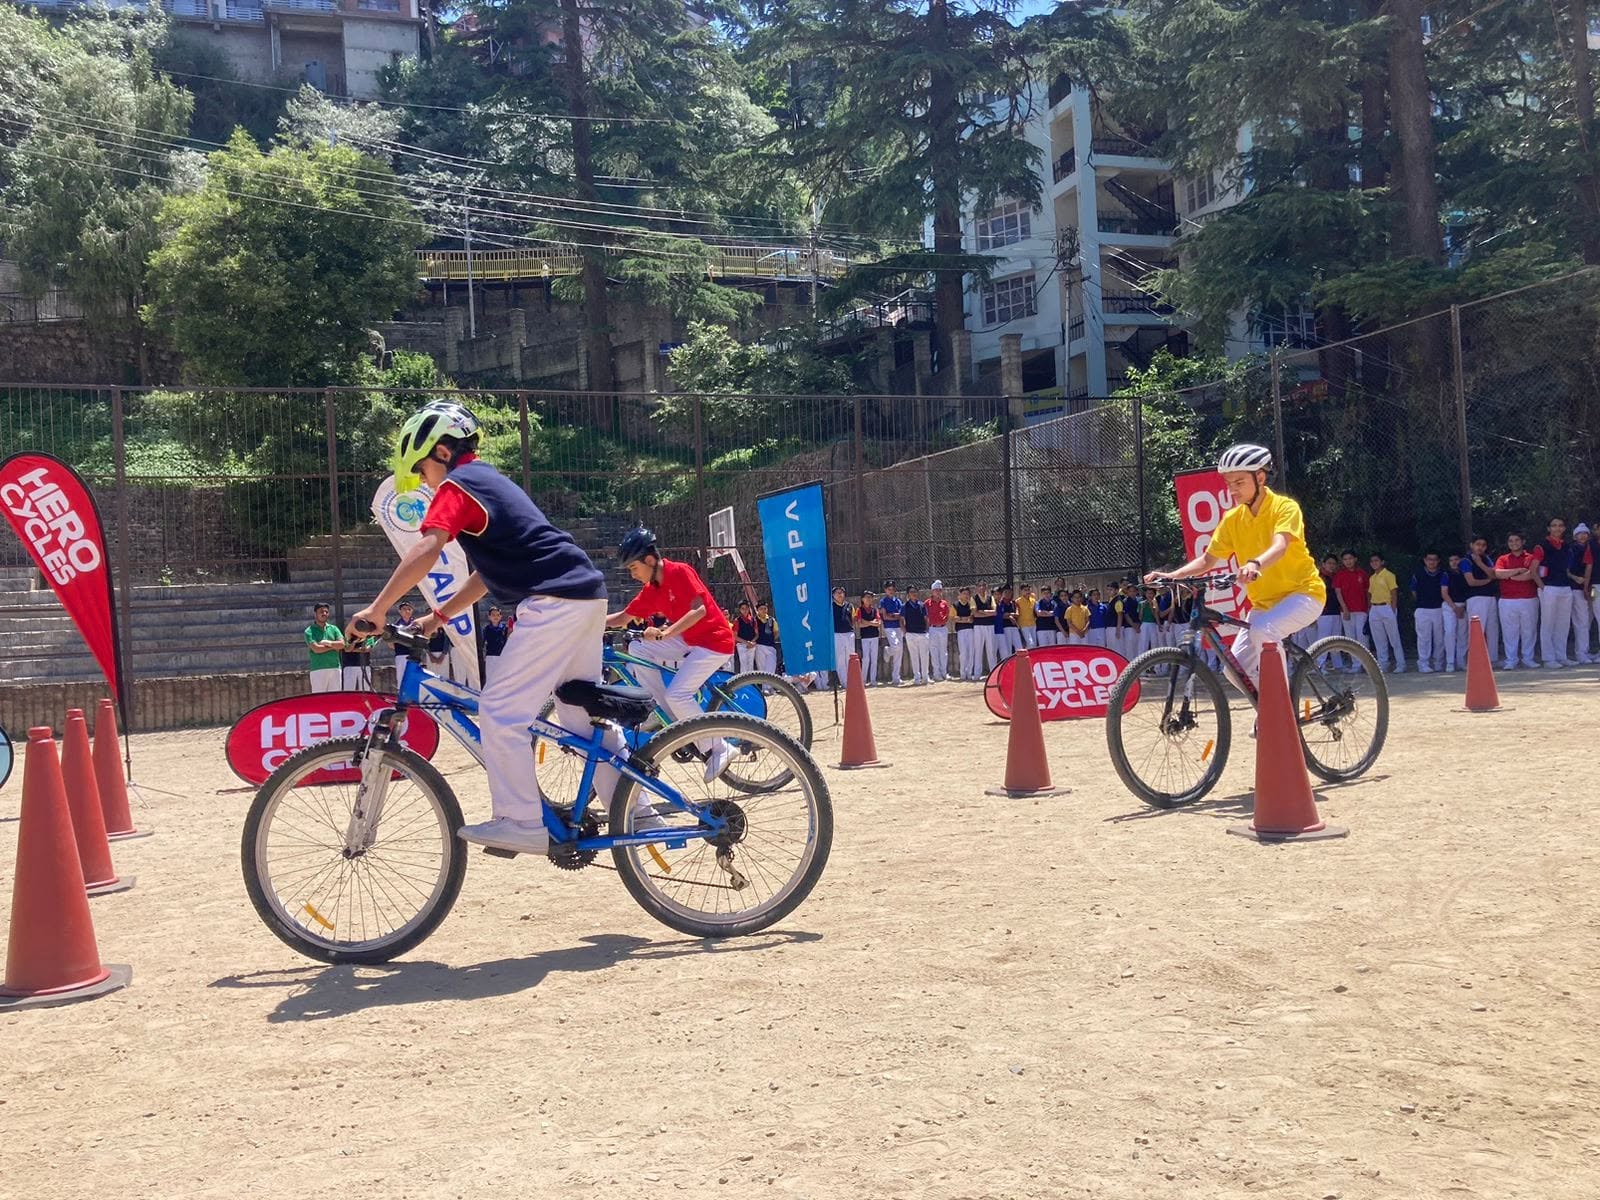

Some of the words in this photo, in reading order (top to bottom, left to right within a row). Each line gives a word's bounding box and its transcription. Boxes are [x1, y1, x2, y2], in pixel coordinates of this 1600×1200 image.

[0, 483, 76, 587] CYCLES
[17, 467, 101, 574] HERO
[1032, 657, 1118, 689] HERO
